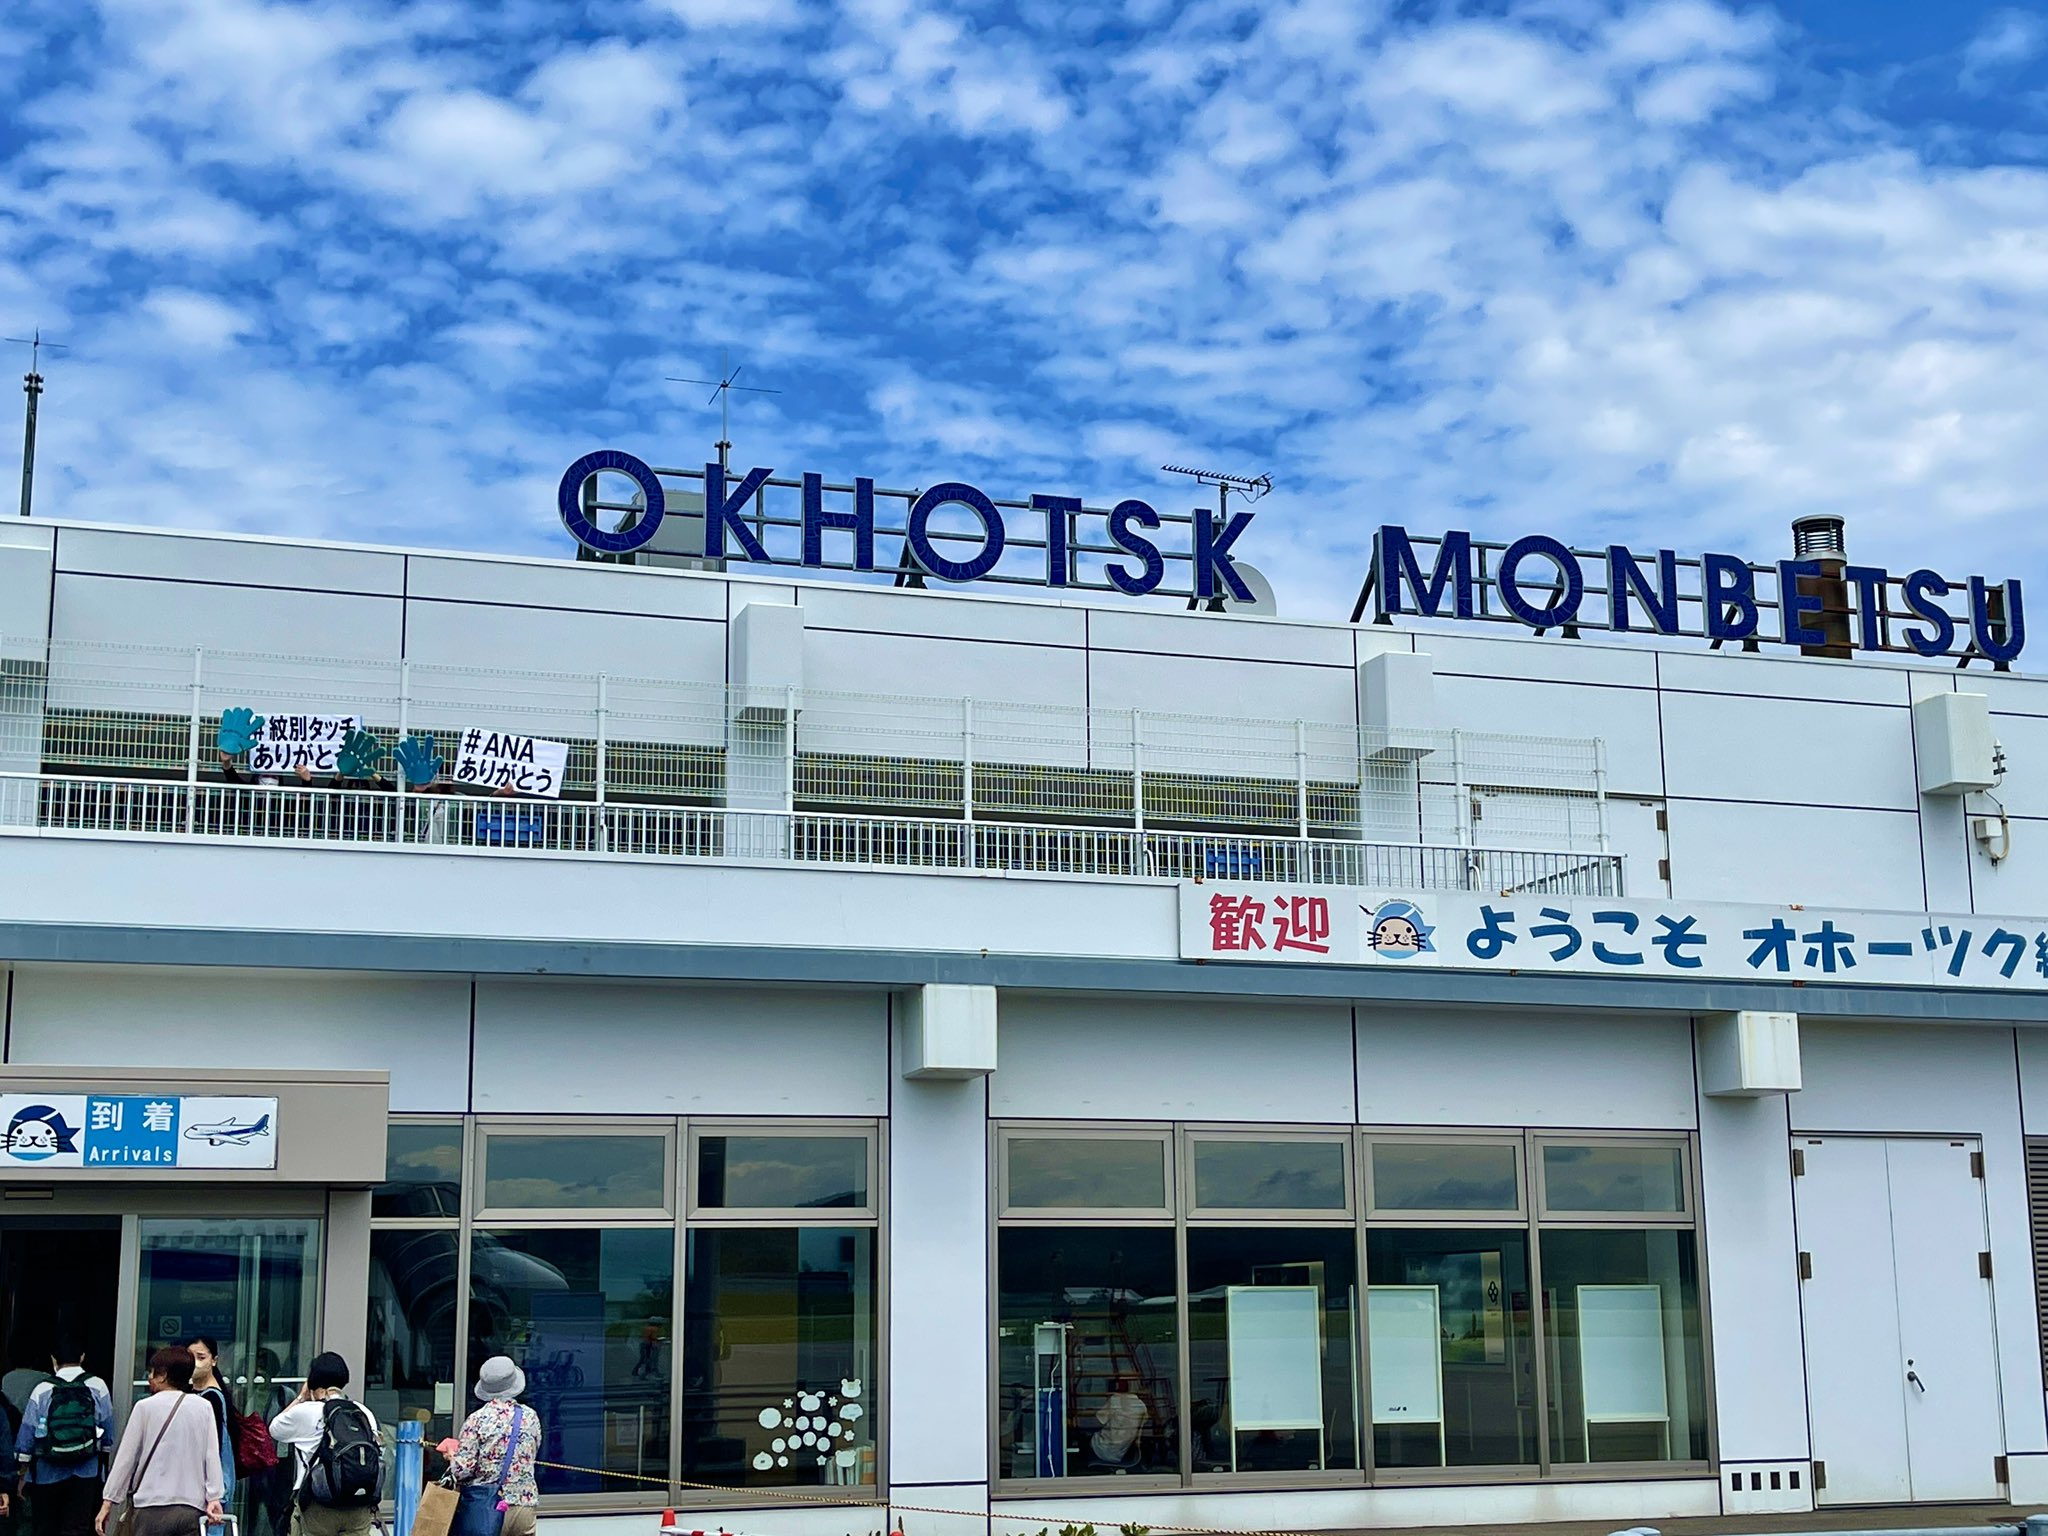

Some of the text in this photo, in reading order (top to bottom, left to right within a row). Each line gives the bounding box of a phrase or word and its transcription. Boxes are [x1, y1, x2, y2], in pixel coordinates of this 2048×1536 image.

[558, 449, 2027, 663] OKHOTSK MONBETSU
[253, 743, 346, 770] ありがと
[457, 756, 552, 793] ありがとう
[1209, 892, 1330, 954] 歓迎
[1466, 904, 1708, 969] ようこそ
[91, 1101, 175, 1133] 到着
[89, 1146, 173, 1163] Arrivals
